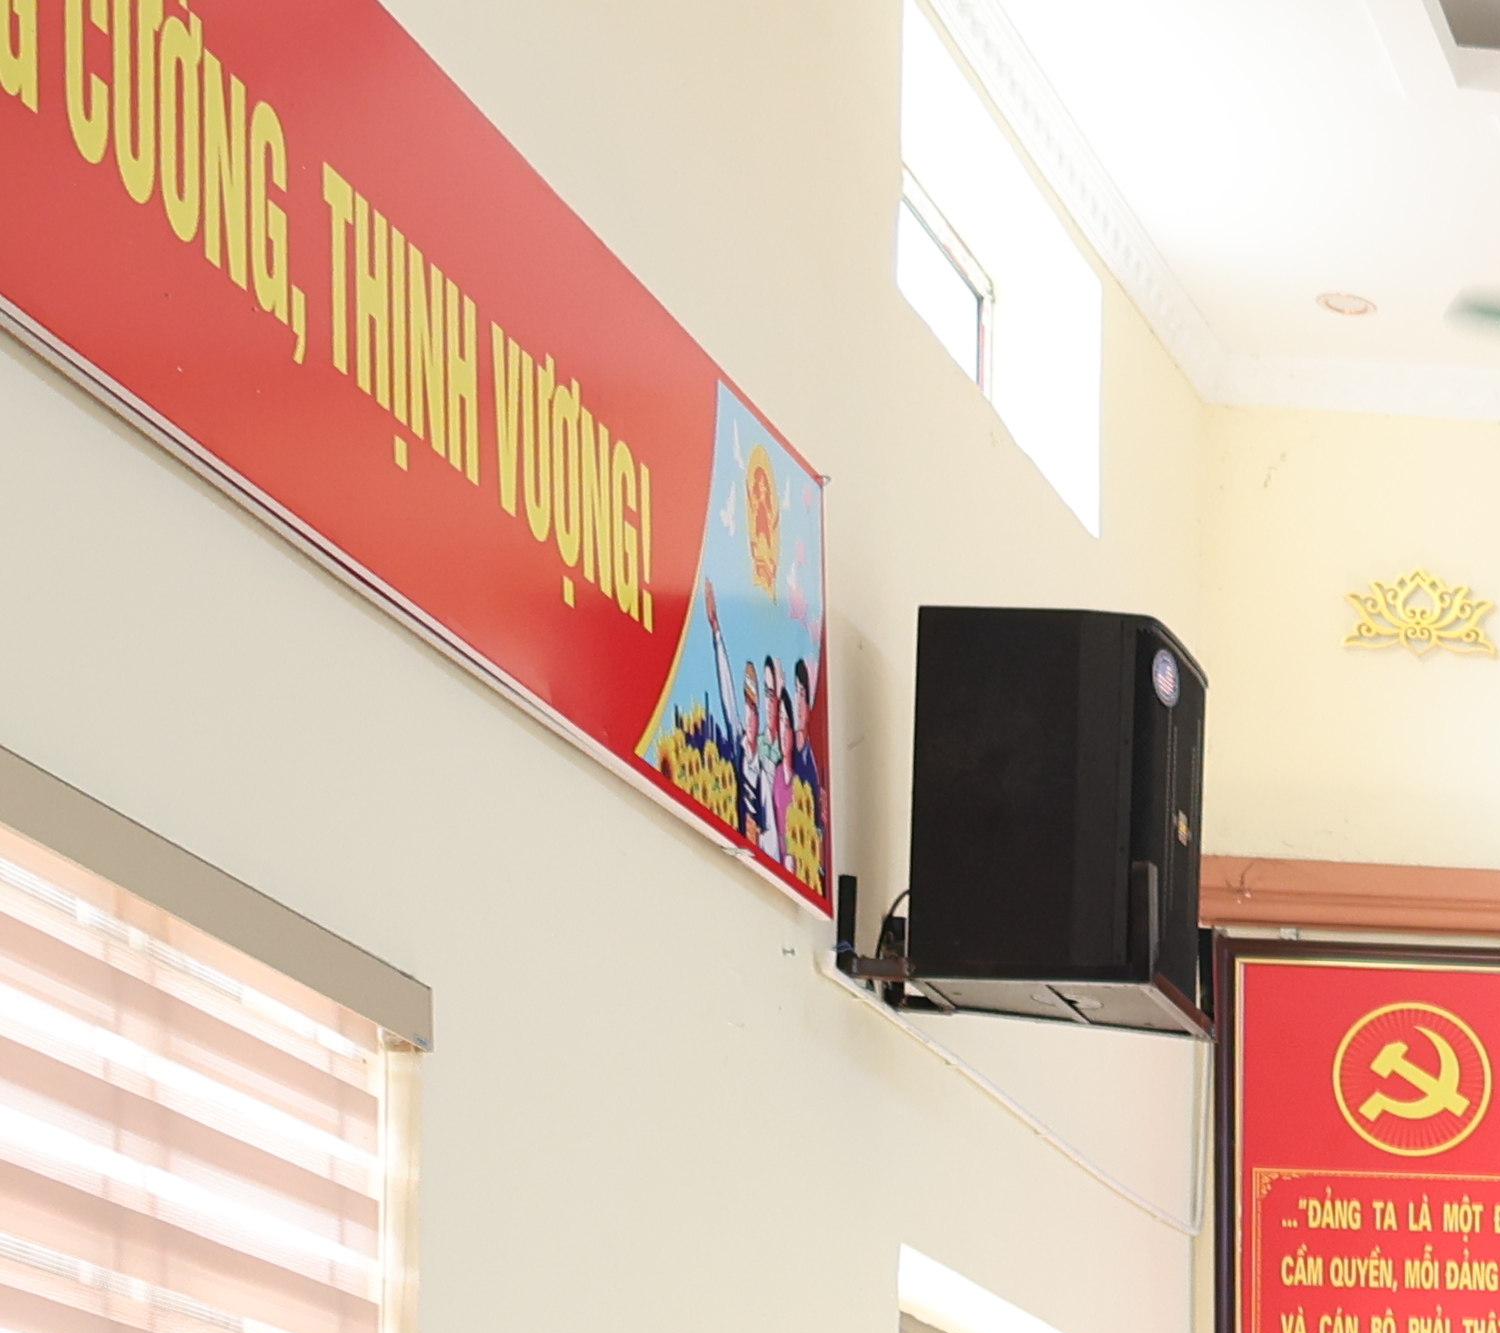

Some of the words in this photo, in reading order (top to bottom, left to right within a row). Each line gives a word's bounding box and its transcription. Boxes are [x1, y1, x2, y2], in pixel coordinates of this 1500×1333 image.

[322, 161, 479, 487] THỊNH
[490, 320, 653, 634] VƯỢNG!
[1281, 1187, 1361, 1230] ..."ĐẢNG
[1371, 1200, 1397, 1230] TA
[1408, 1194, 1432, 1232] LÀ
[1442, 1195, 1484, 1242] MỘT
[1280, 1244, 1323, 1286] CẦM
[1329, 1245, 1398, 1292] QUYỀN,
[1404, 1244, 1439, 1290] MỖI
[1444, 1248, 1499, 1292] ĐẢNG
